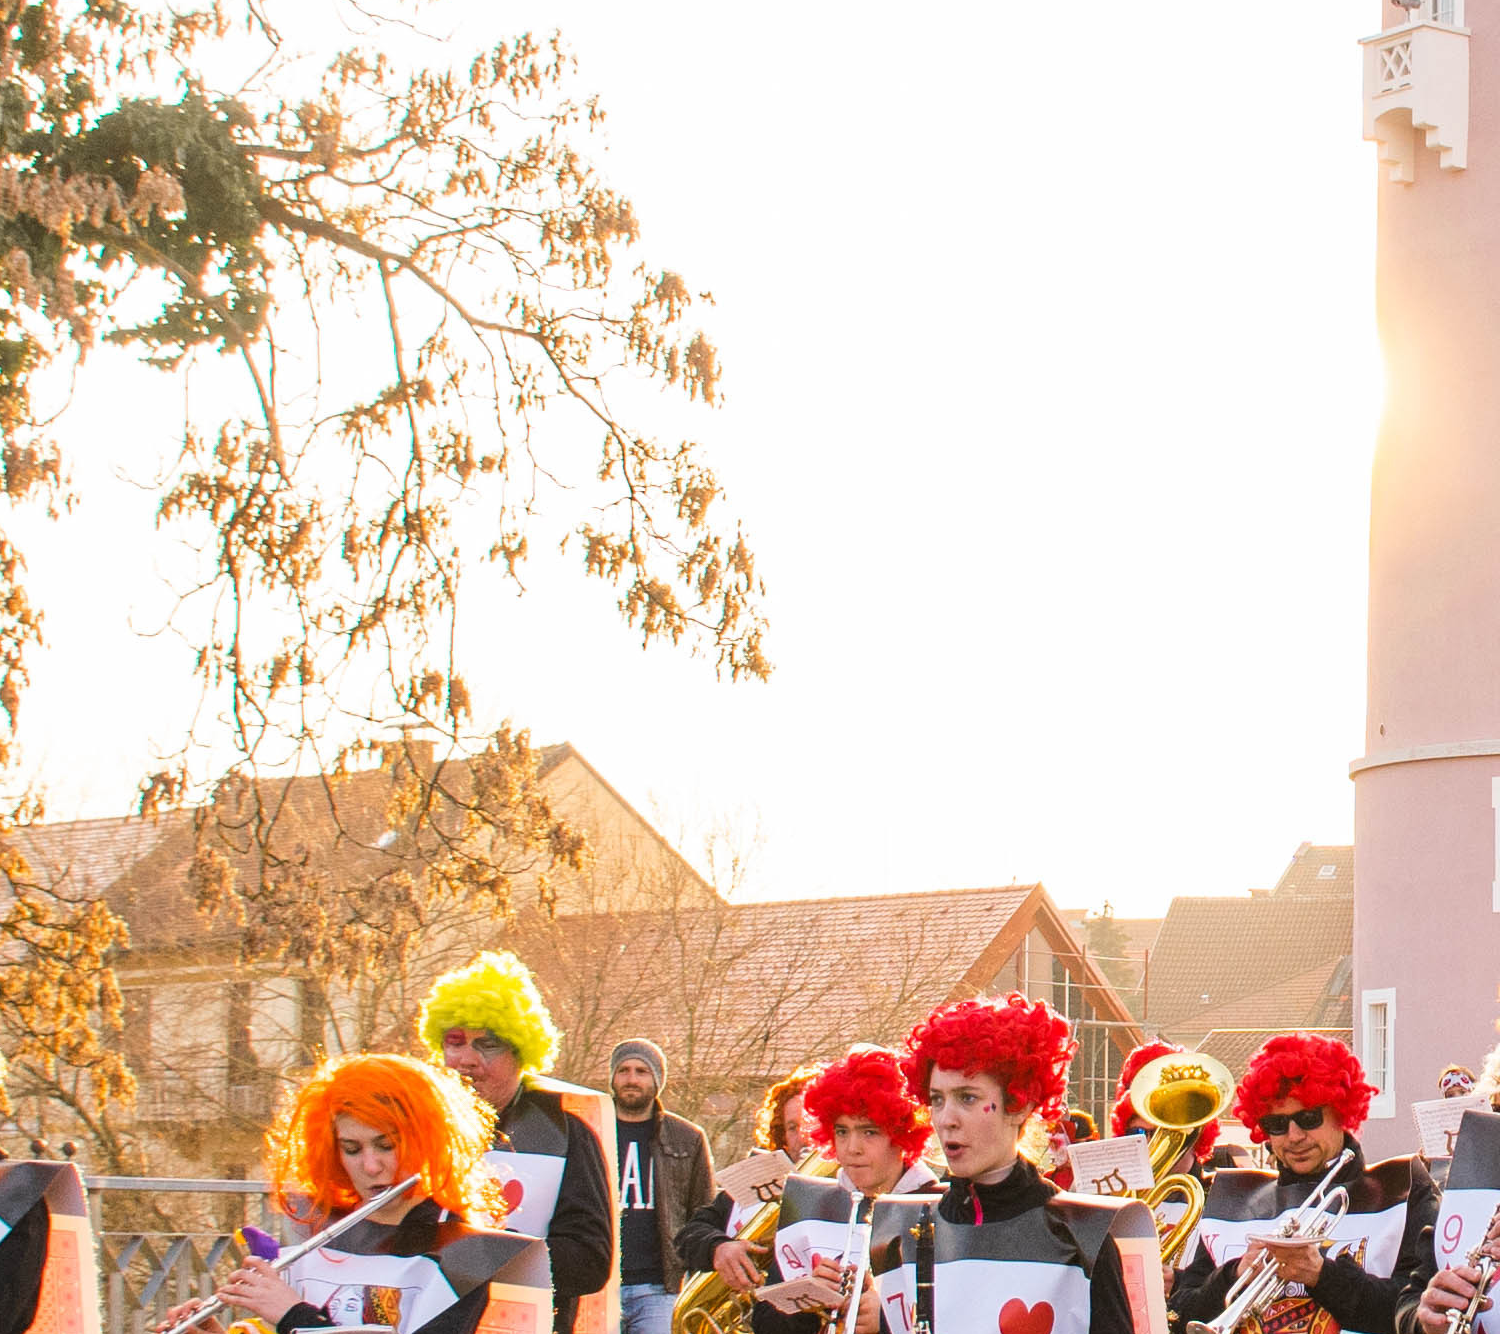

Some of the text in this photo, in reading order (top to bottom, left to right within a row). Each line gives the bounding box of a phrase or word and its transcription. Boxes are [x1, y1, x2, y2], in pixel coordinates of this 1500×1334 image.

[1441, 1214, 1463, 1254] 9
[782, 1243, 805, 1269] Q
[886, 1292, 910, 1331] 7
